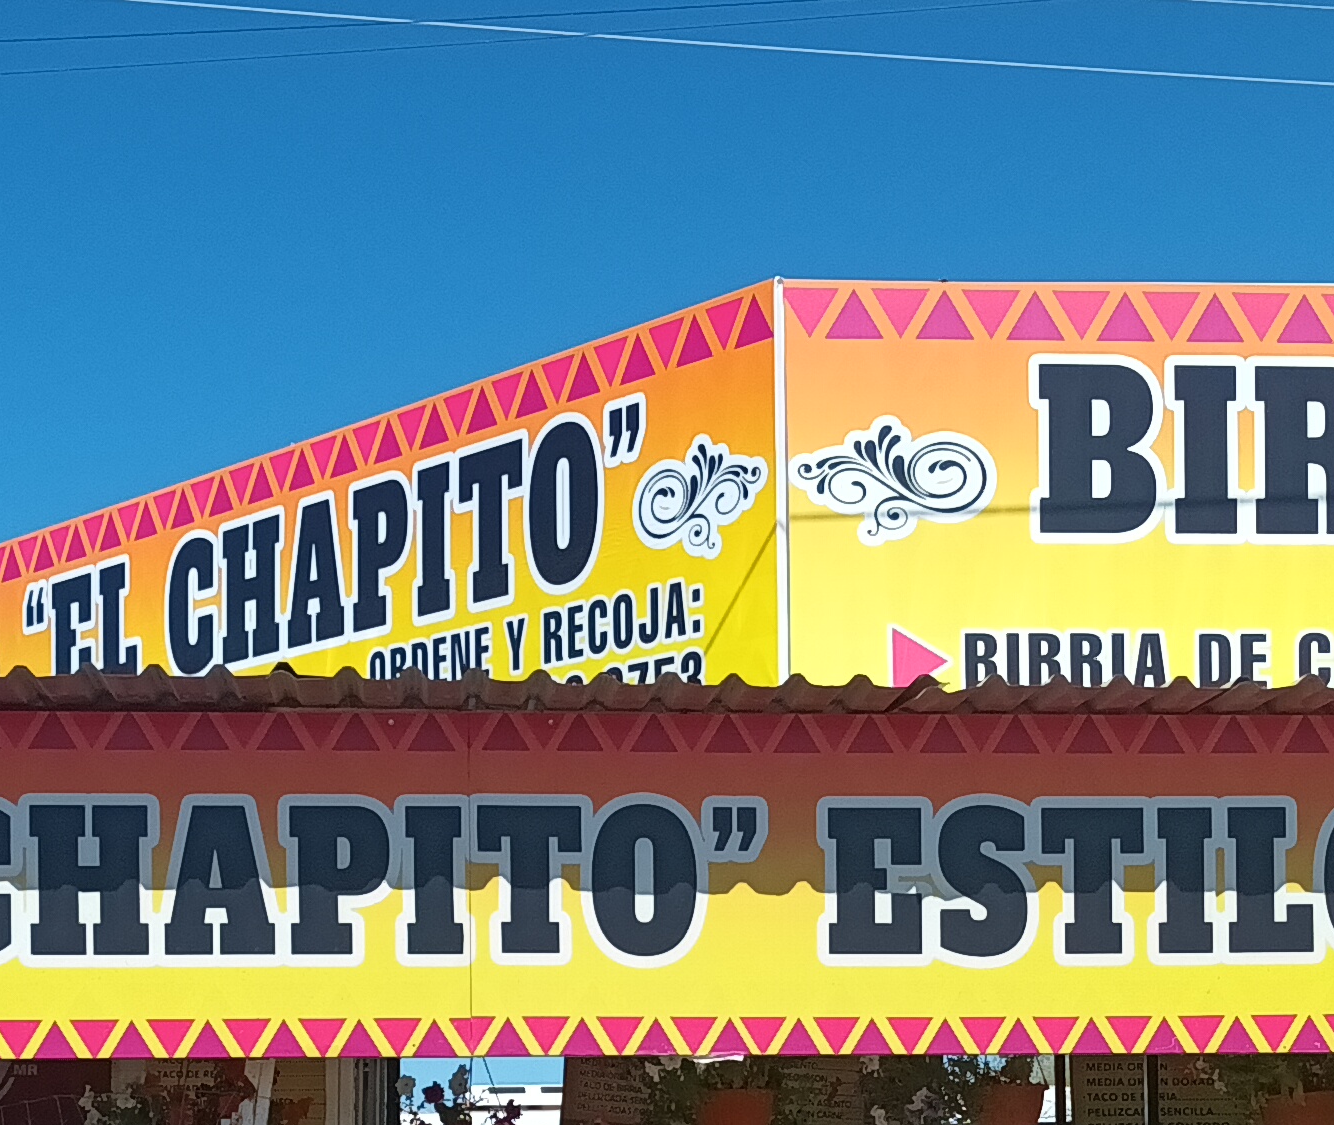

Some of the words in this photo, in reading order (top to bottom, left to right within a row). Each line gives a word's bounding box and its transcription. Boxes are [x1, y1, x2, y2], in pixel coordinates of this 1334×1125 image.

[24, 561, 139, 677] “EL
[167, 400, 642, 678] CHAPITO”
[505, 617, 527, 673] Y
[542, 581, 704, 665] RECOJA:
[963, 632, 1168, 688] BIRRIA
[1197, 632, 1268, 688] DE
[1085, 1062, 1123, 1071] MEDIA
[1126, 1062, 1168, 1071] ORN
[1086, 1077, 1124, 1087] MEDIA
[1127, 1077, 1169, 1087] ORN
[1172, 1077, 1215, 1087] DORAD
[1086, 1092, 1118, 1102] TACO
[1120, 1092, 1137, 1102] DE
[1087, 1107, 1146, 1117] PELLIZCA
[1159, 1107, 1214, 1117] SENCILLA
